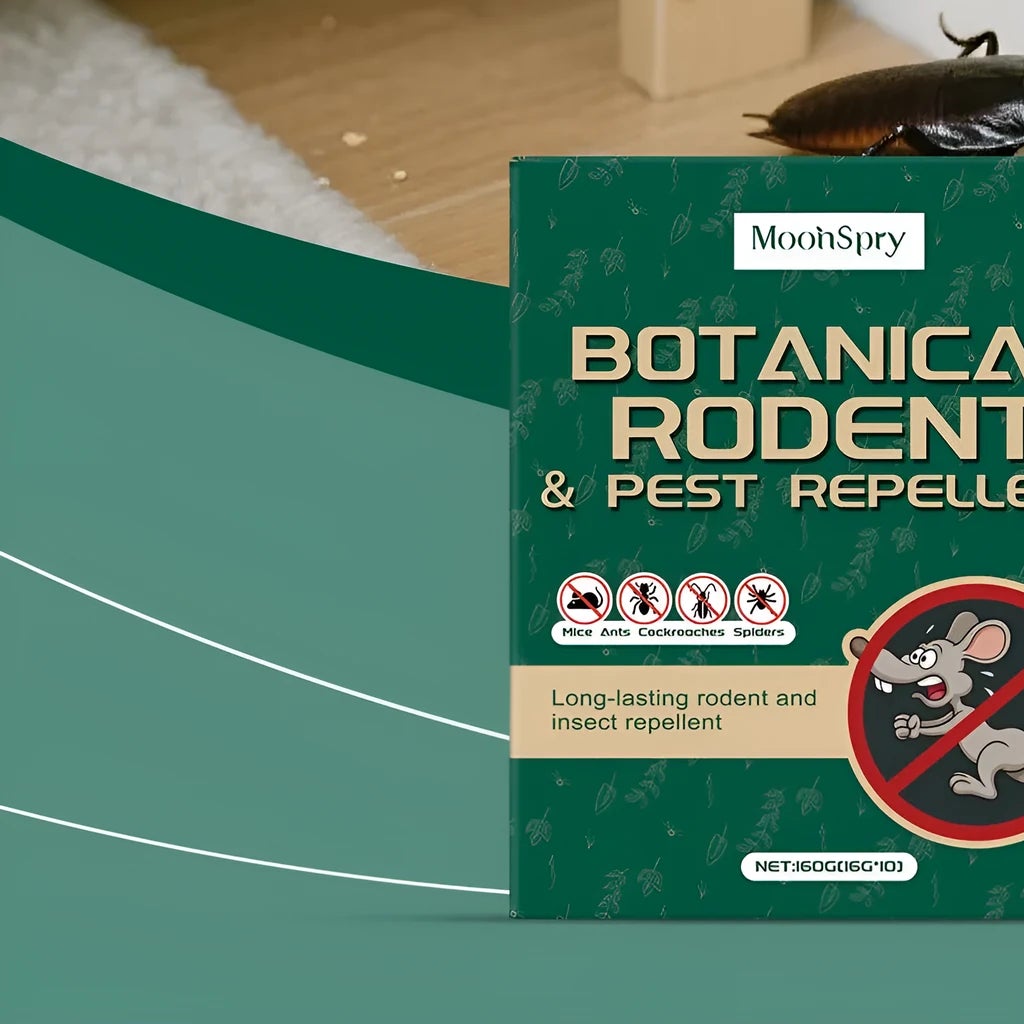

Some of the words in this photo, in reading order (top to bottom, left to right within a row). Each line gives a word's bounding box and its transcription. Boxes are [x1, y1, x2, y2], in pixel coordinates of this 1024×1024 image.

[752, 225, 906, 257] MoonSpry
[541, 470, 576, 509] &
[607, 474, 758, 509] PEST
[562, 627, 593, 637] Mice
[600, 627, 631, 637] Ants
[638, 627, 725, 637] Cockroaches
[733, 627, 785, 638] Spiders
[552, 689, 689, 710] Long-lasting
[698, 689, 768, 706] rodent
[776, 689, 817, 706] and
[552, 713, 618, 730] insect
[625, 713, 723, 734] repellent
